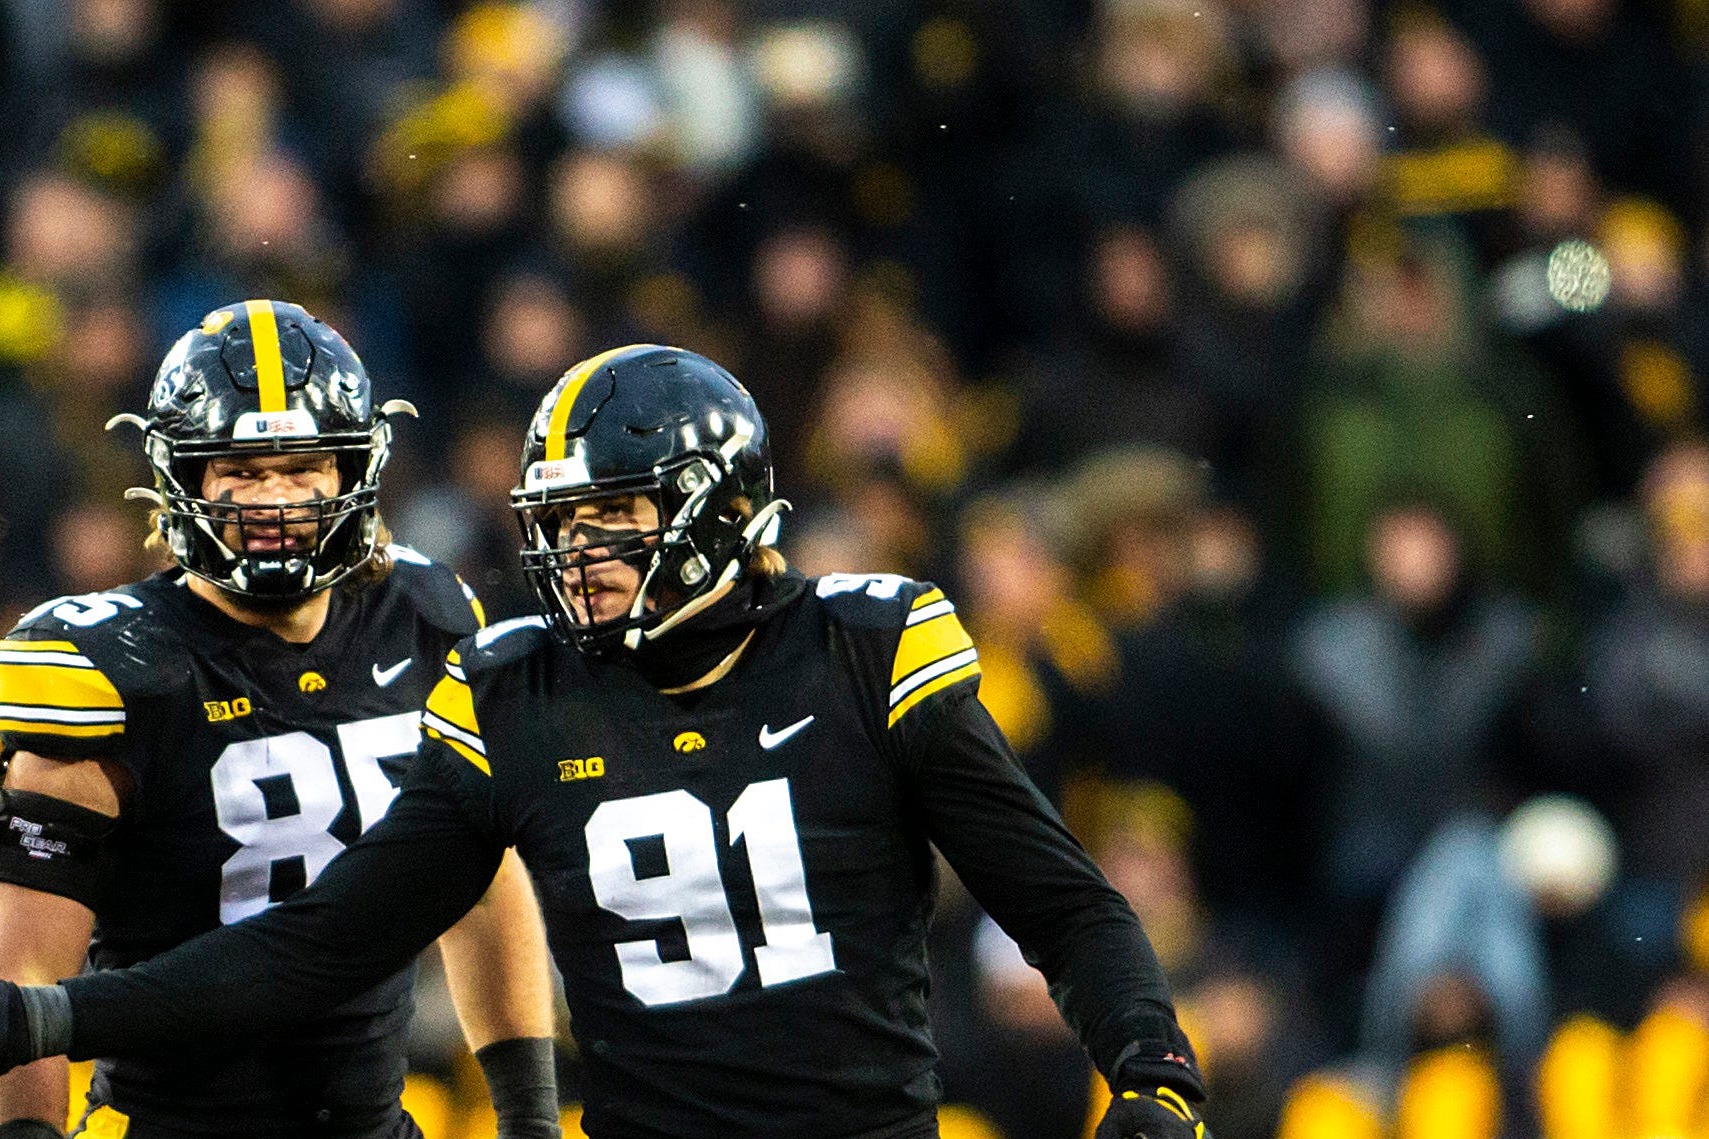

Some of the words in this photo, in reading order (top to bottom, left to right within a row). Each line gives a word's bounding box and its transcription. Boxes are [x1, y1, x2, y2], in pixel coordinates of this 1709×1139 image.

[9, 815, 43, 836] PRO
[210, 710, 423, 926] 85
[584, 777, 837, 1006] 91
